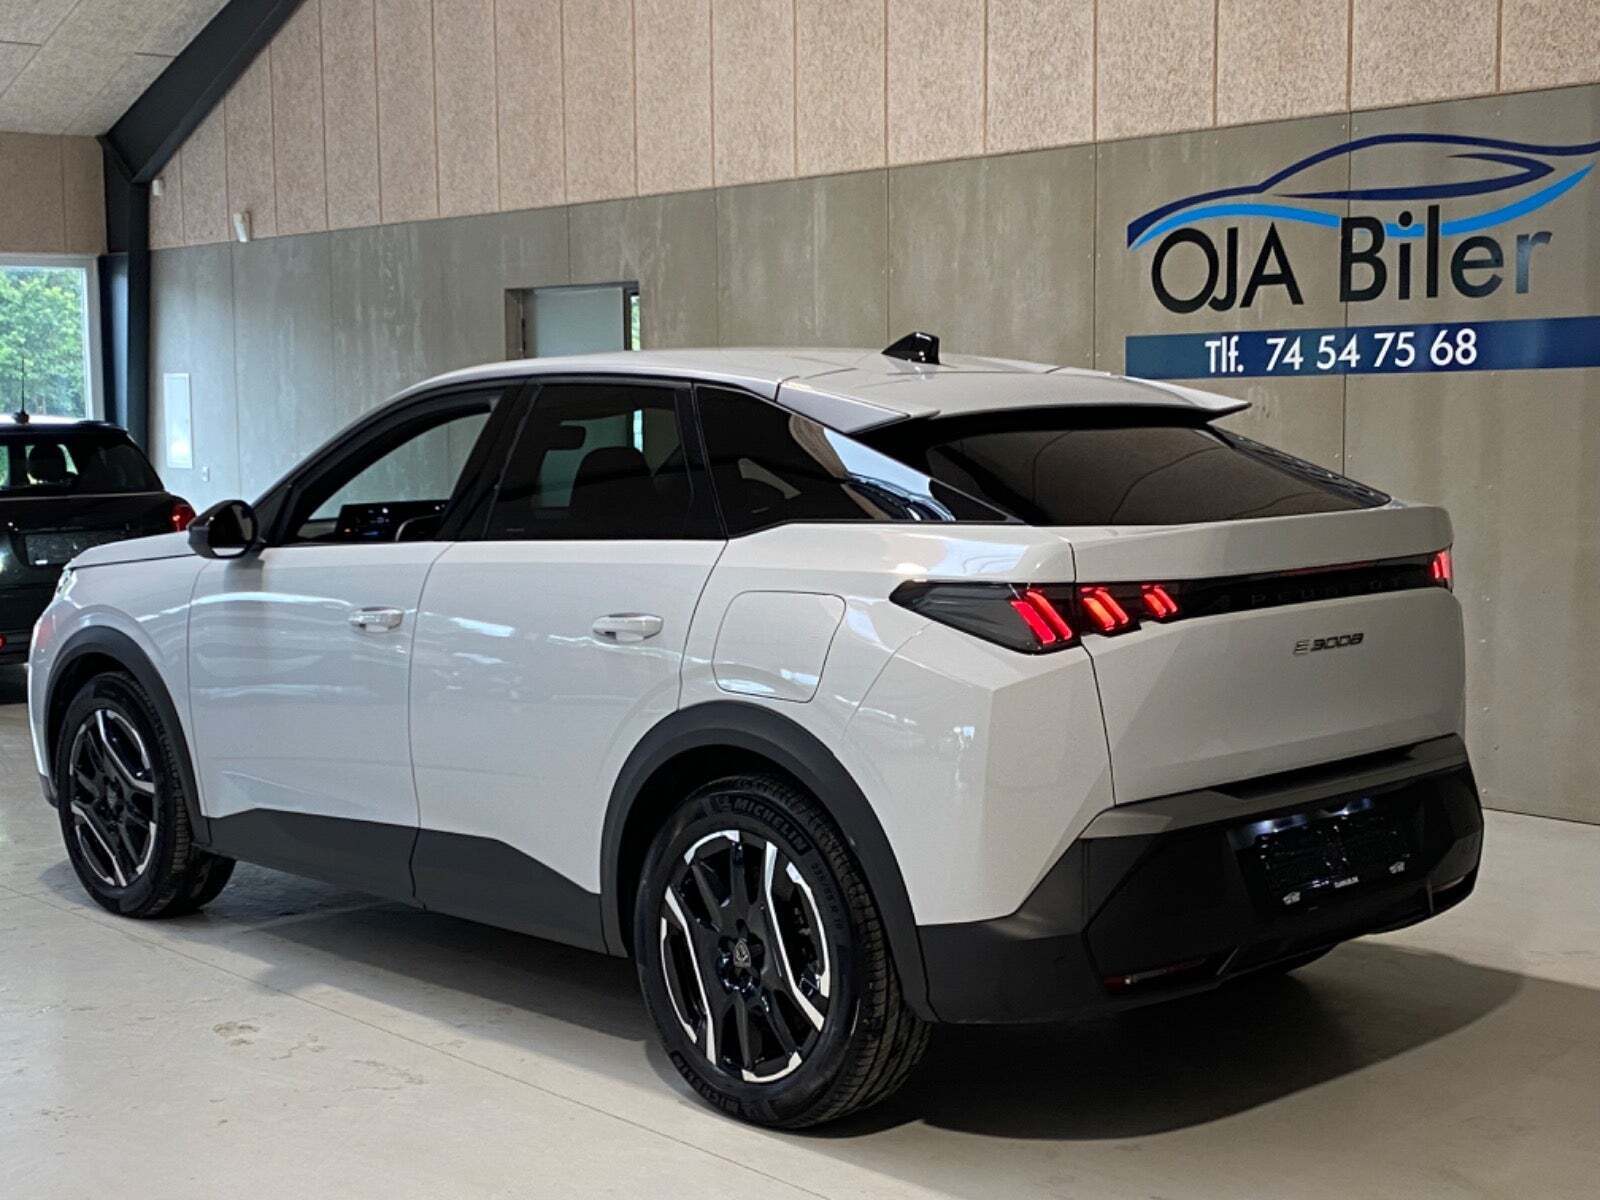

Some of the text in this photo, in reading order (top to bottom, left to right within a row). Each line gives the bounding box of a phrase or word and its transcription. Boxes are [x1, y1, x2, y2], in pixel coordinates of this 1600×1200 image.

[1151, 204, 1553, 314] OJA Biler
[1204, 328, 1478, 374] Tlf. 74 54 75 68
[732, 797, 810, 851] MICHELIN
